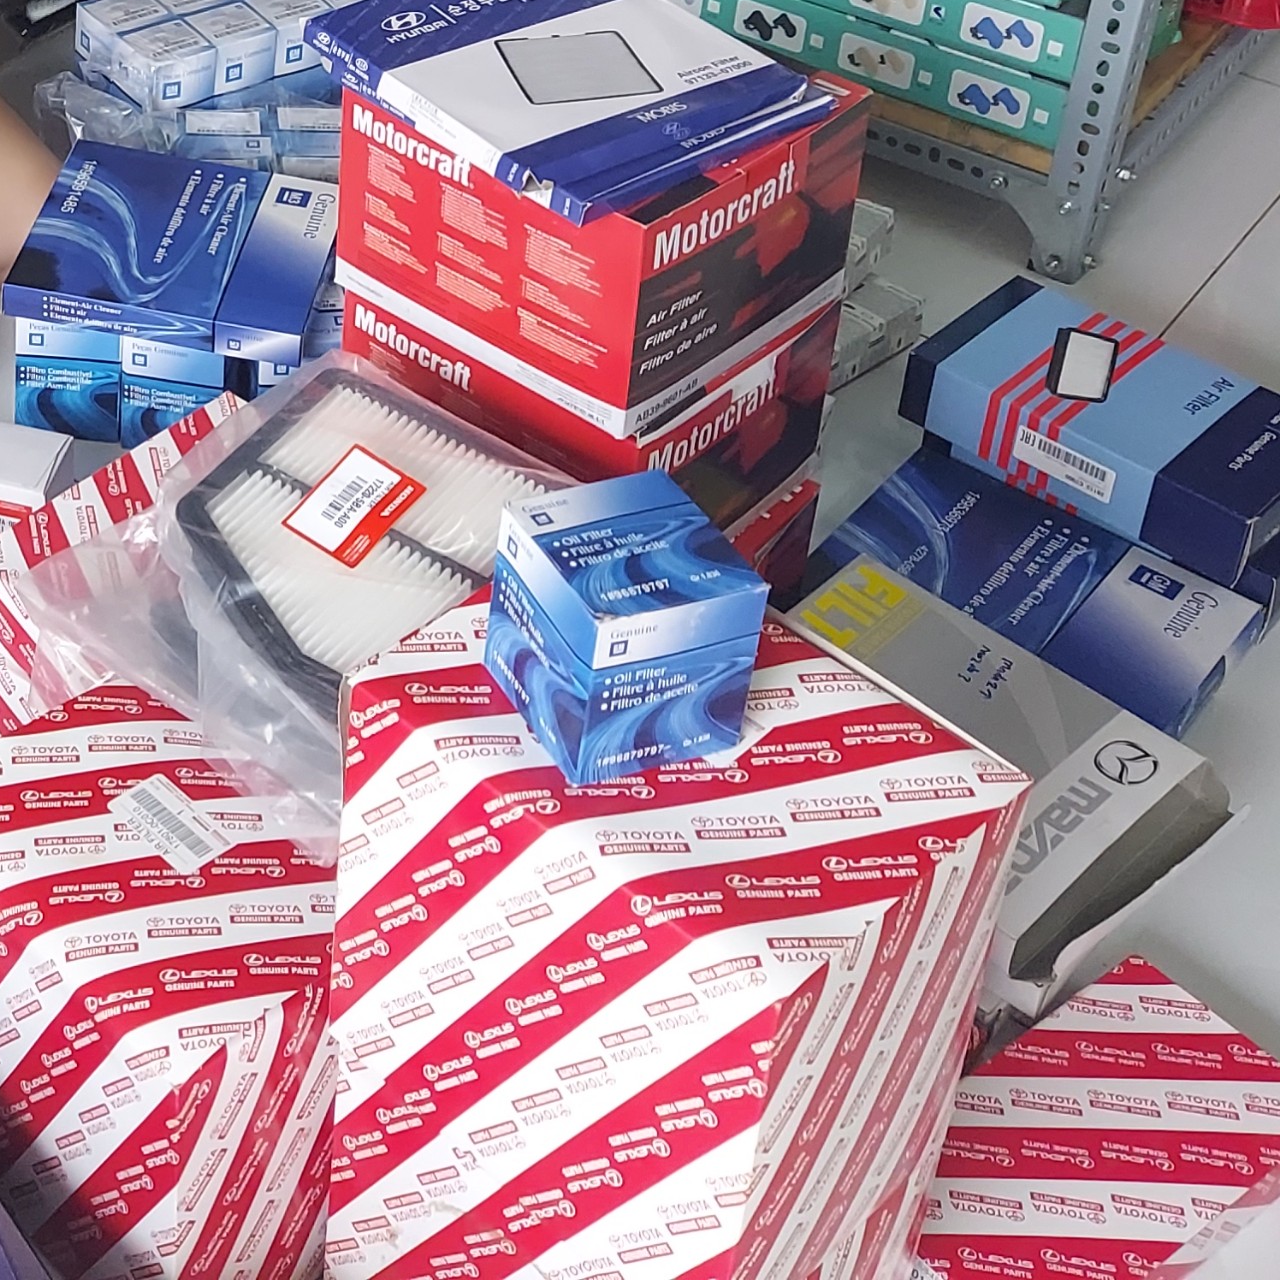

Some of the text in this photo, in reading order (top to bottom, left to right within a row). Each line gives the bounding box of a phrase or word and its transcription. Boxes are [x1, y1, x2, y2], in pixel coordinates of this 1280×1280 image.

[386, 20, 449, 44] HYUNDAI
[714, 55, 740, 69] Filter
[636, 102, 688, 124] MOBIS
[352, 104, 471, 186] Motorcraft
[198, 178, 223, 215] Filtre air
[305, 193, 336, 240] Genuine
[653, 159, 795, 270] Motorcraft
[206, 224, 228, 255] Cleaner
[49, 296, 122, 315] Element-Air Cleaner
[50, 304, 87, 317] Filtre air
[646, 291, 703, 327] Air Filter
[690, 307, 707, 327] air
[354, 304, 471, 392] Motorcraft
[639, 322, 718, 376] Filtro de aire
[1183, 377, 1236, 415] Air Filter
[1228, 431, 1277, 472] Genuine Parts
[379, 485, 414, 517] HONDA
[562, 527, 614, 547] Oil Filter
[570, 532, 644, 558] Filtre à huile
[579, 538, 668, 568] Filtro de aceite
[1022, 533, 1068, 578] Filtre air
[1006, 589, 1043, 626] Cleaner
[1162, 591, 1219, 639] Genuine
[612, 672, 688, 700] Filtre à huile
[614, 666, 668, 685] Oil Filter
[610, 682, 698, 712] Filtro de aceite
[32, 745, 79, 755] TOYOTA
[108, 734, 156, 744] TOYOTA
[903, 774, 968, 787] TOYOTA
[24, 799, 89, 809] GENUINE PARTS
[714, 815, 780, 826] TOYOTA
[700, 829, 746, 839] GENUINE
[834, 867, 918, 881] GENUINE PARTS
[83, 930, 139, 946] TOYOTA
[164, 978, 235, 992] GENUINE PARTS
[1030, 1092, 1081, 1107] TOYOTA
[1106, 1093, 1160, 1108] TOYOTA
[963, 1261, 1032, 1279] GENUINE PARTS
